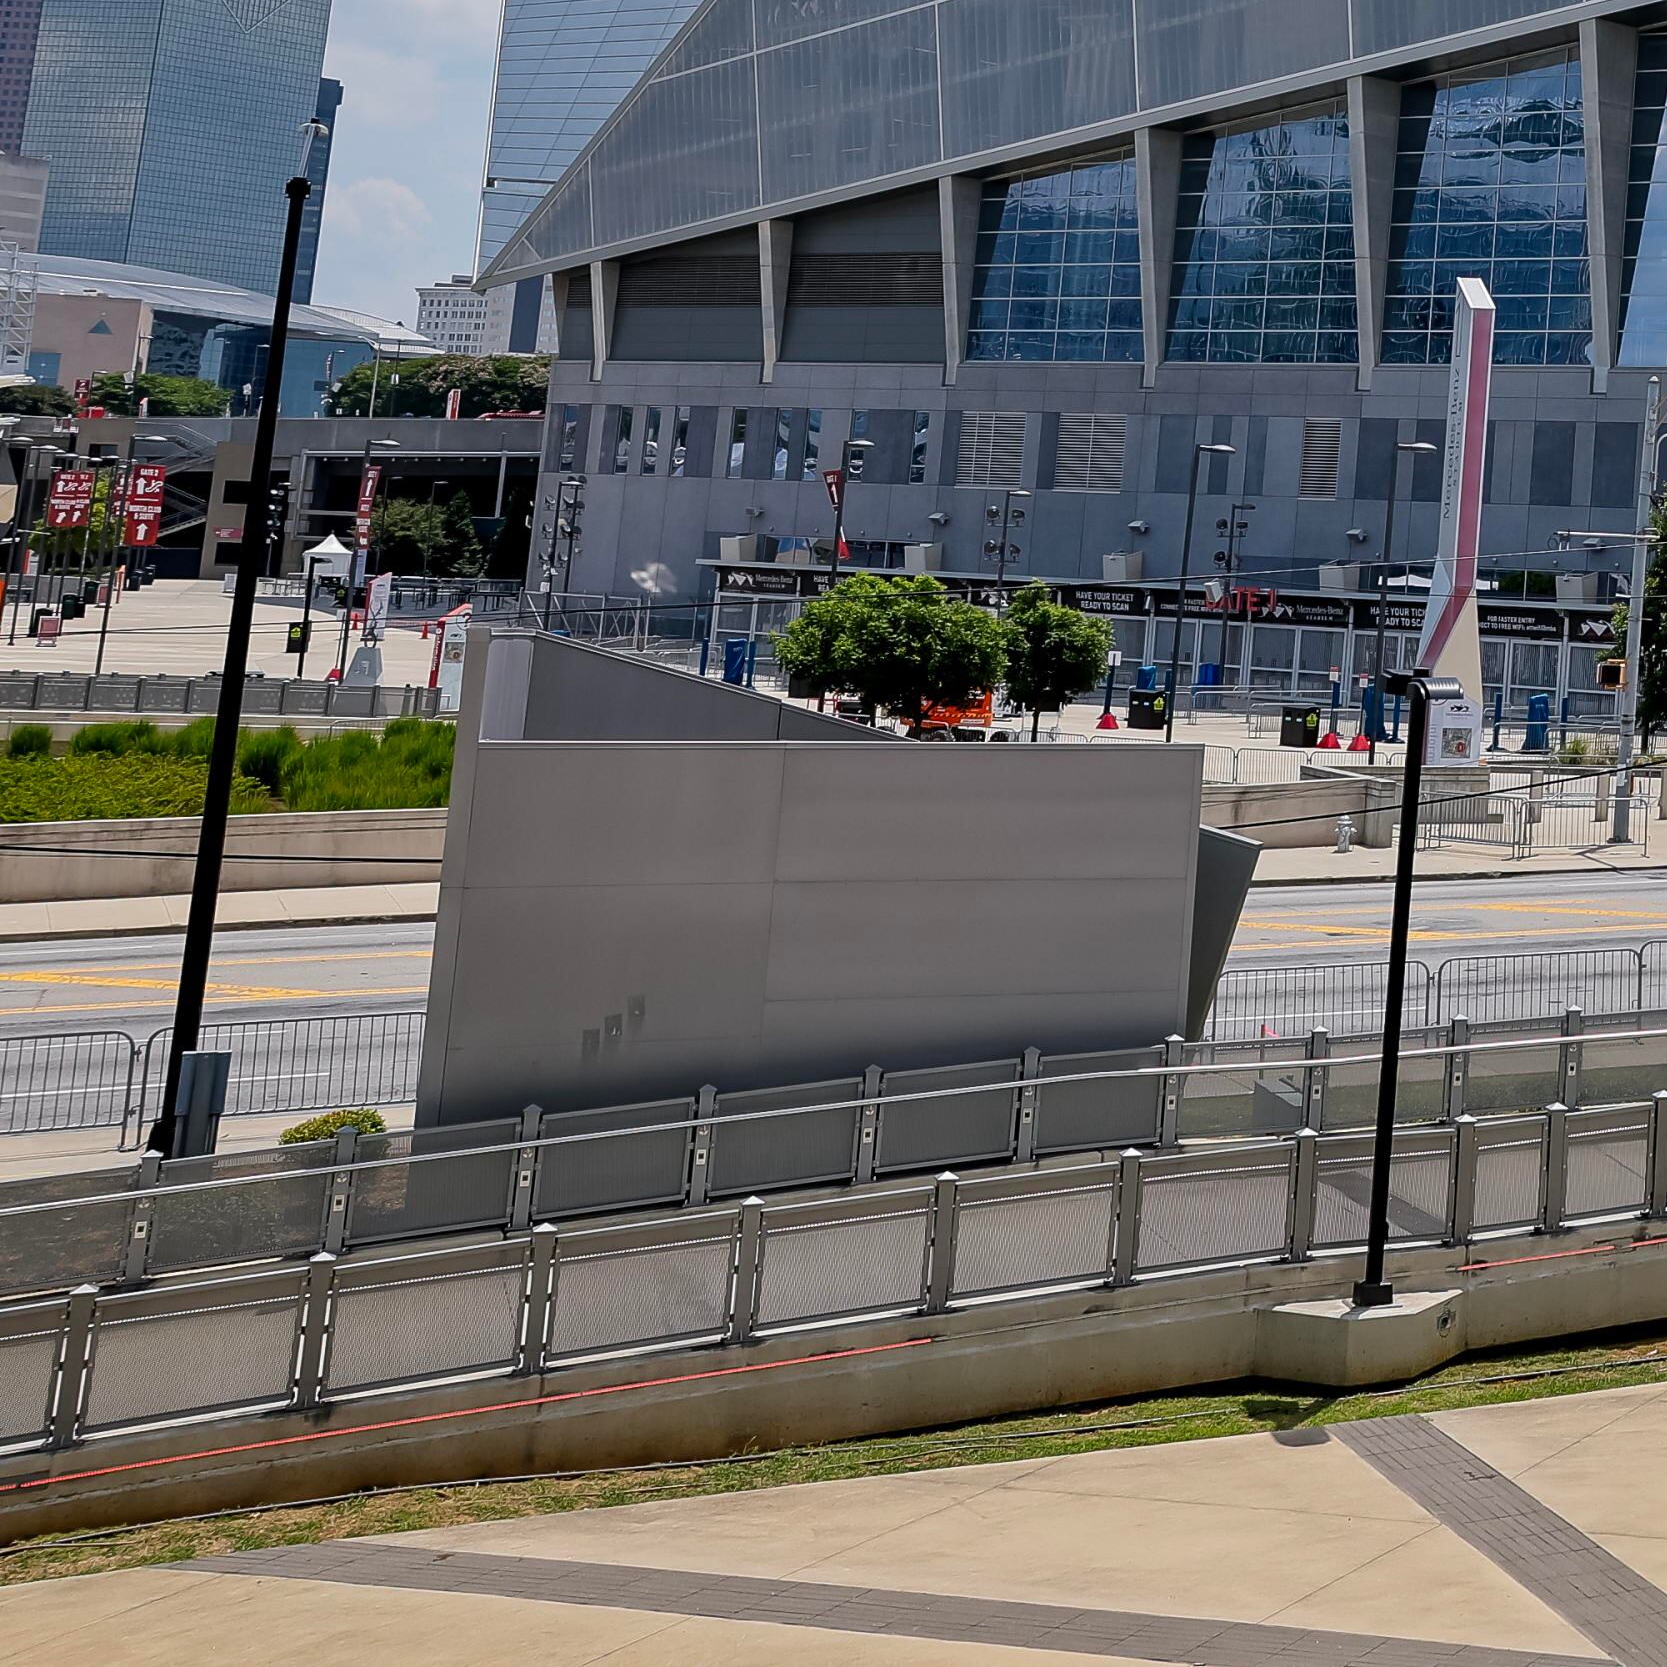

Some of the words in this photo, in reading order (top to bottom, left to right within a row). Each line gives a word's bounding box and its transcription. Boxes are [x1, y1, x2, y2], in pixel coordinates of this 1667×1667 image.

[1443, 368, 1460, 519] Mercedes-Benz
[140, 468, 153, 476] GATE
[154, 469, 159, 477] 2
[1075, 590, 1093, 600] HAVE
[1093, 592, 1111, 600] YOUR
[1111, 593, 1134, 602] TICKET
[1080, 600, 1101, 610] READY
[1102, 602, 1111, 610] TO
[1111, 602, 1130, 611] SCAN
[1295, 604, 1344, 615] Mercedes-Benz
[1370, 606, 1389, 615] HAE
[1390, 607, 1410, 617] YOUR
[1400, 617, 1411, 627] TO
